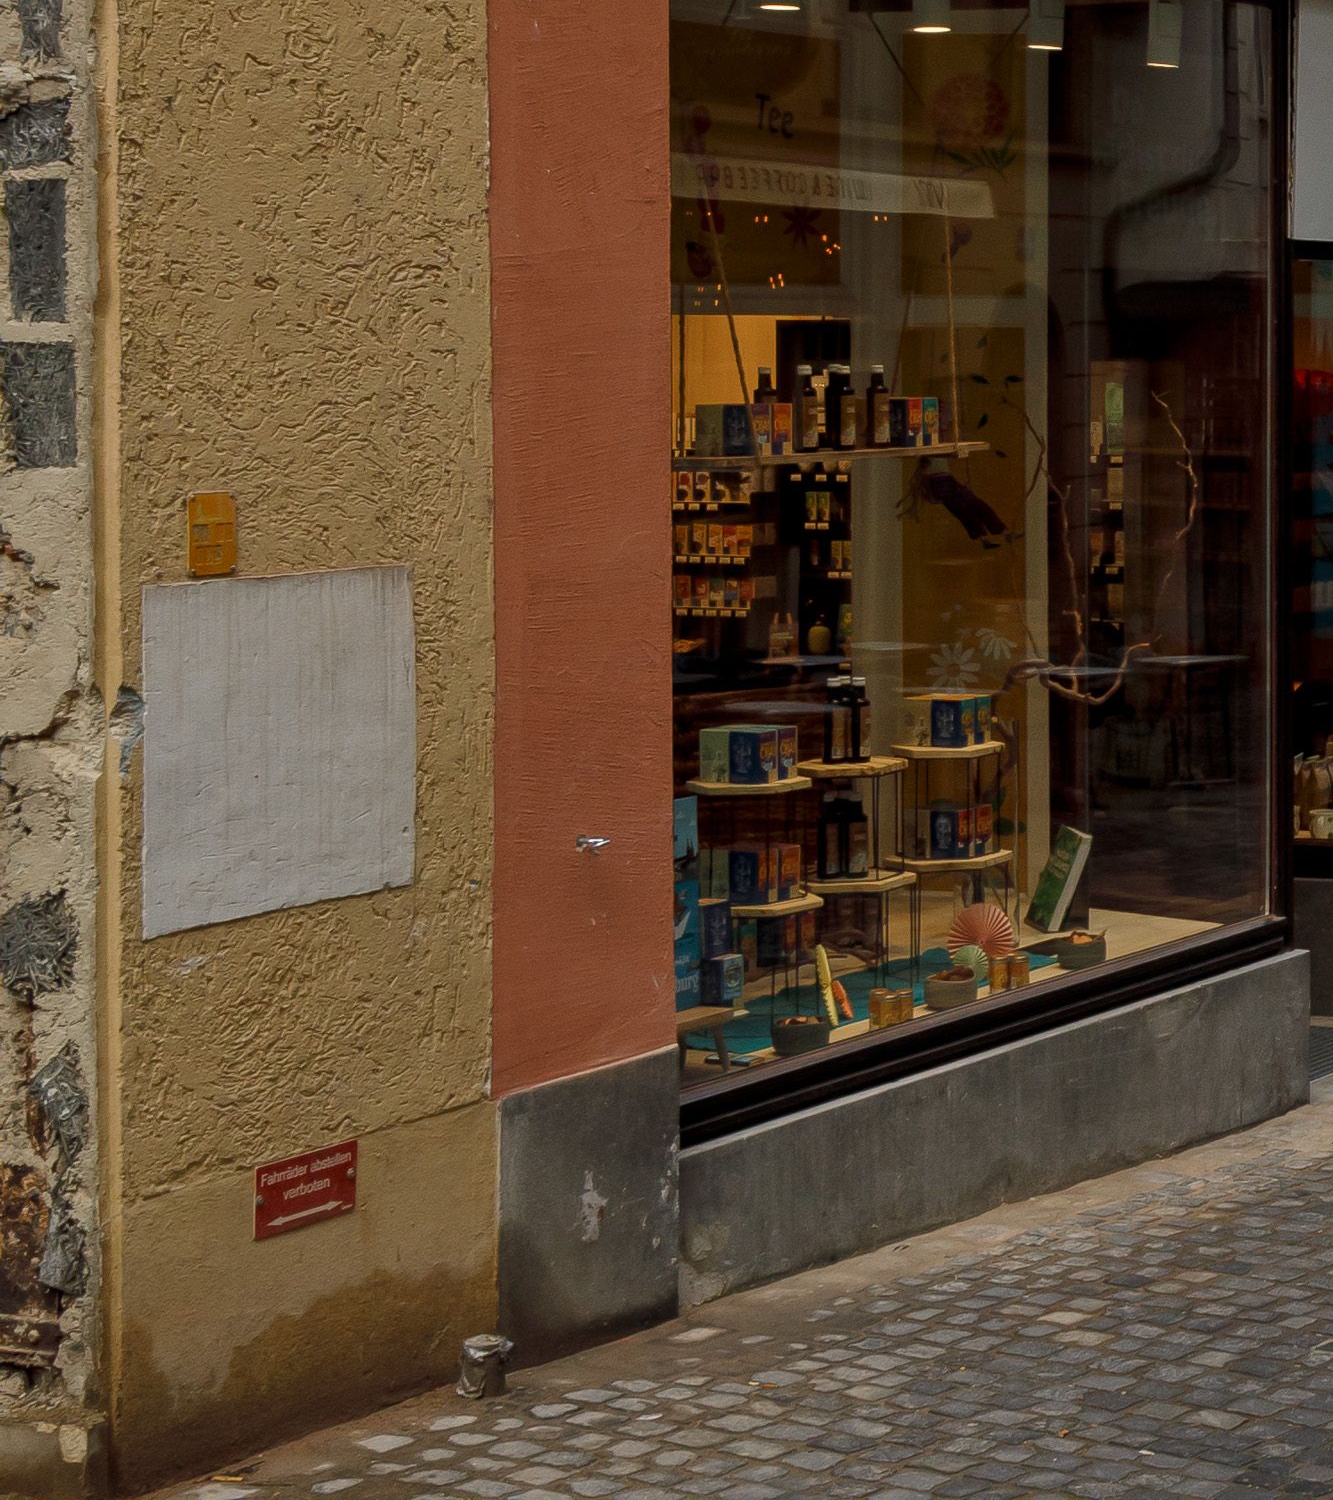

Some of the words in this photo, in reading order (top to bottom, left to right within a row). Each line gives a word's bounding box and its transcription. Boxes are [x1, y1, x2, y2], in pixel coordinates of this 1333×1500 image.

[754, 93, 797, 138] Tee
[261, 1165, 307, 1187] Fahrräder
[310, 1152, 351, 1172] abstellen
[283, 1178, 330, 1200] verboten
